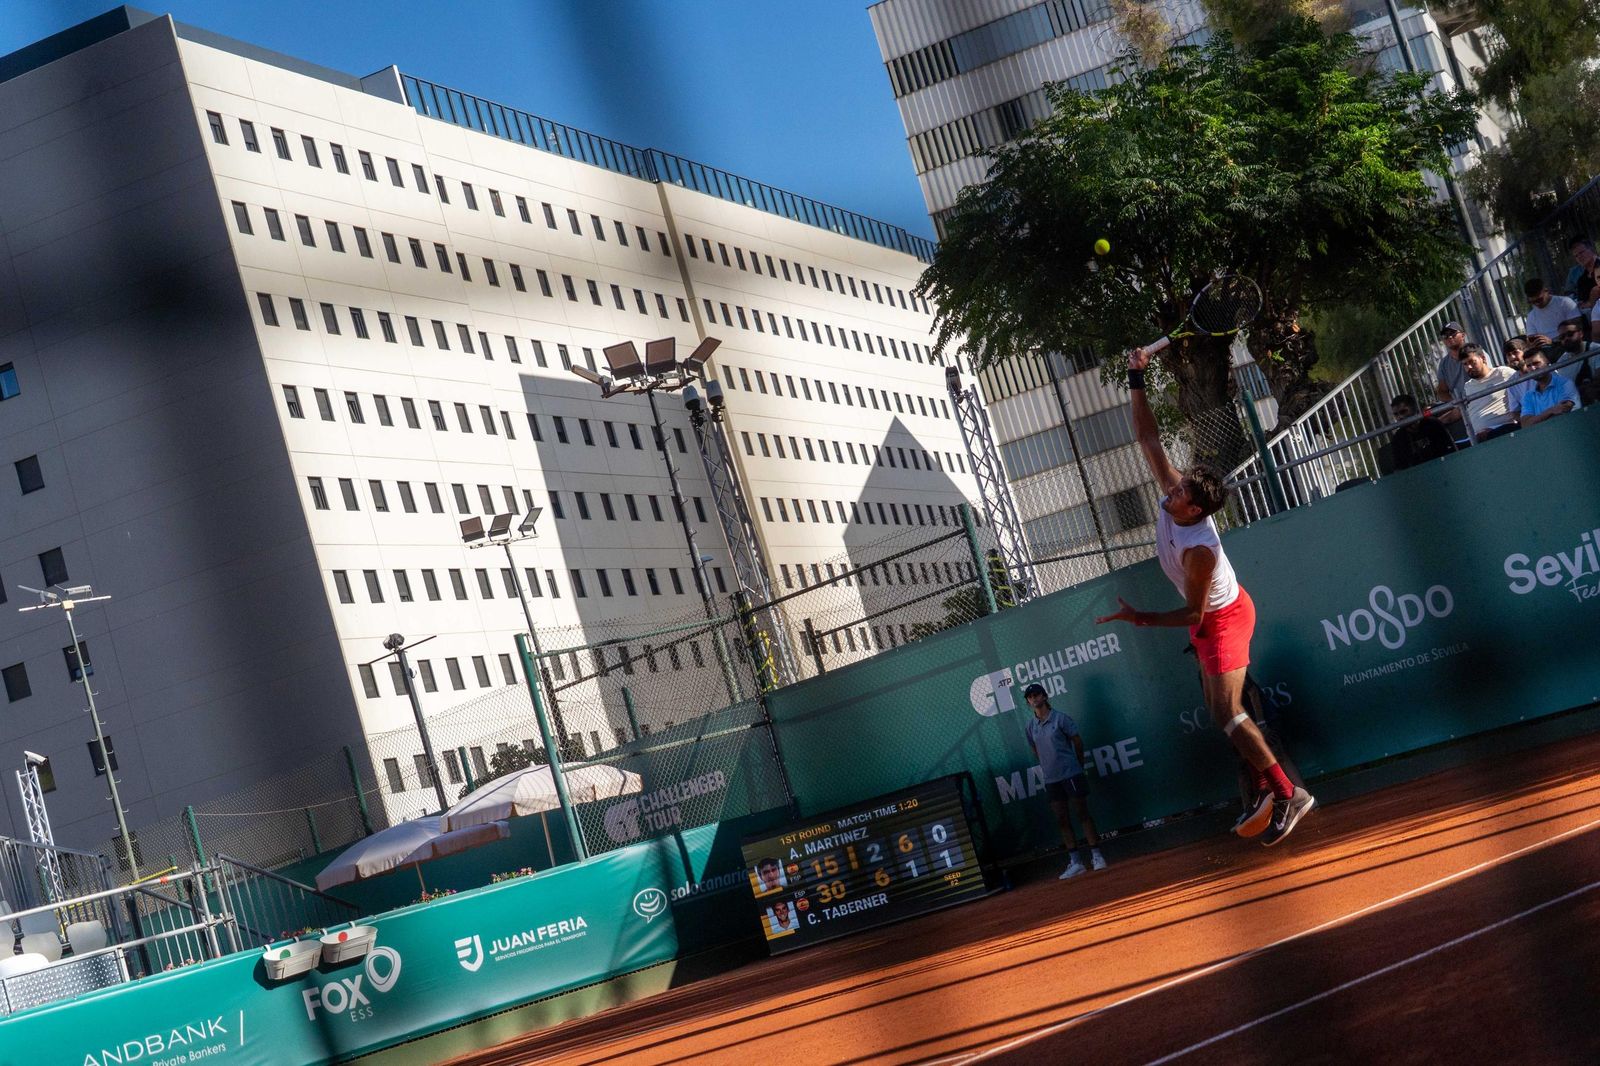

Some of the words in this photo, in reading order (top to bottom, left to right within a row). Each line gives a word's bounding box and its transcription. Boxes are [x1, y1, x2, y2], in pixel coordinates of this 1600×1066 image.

[1014, 632, 1122, 684] CHALLENGER
[997, 677, 1012, 688] ATP
[1020, 674, 1068, 699] UR
[640, 769, 727, 813] CHALLENGER
[995, 736, 1144, 805] MARE
[780, 834, 797, 846] 1ST
[799, 824, 832, 840] ROUND
[837, 811, 873, 830] MATCH
[872, 804, 898, 822] TIME
[899, 798, 919, 811] 1:20
[789, 847, 803, 860] A.
[804, 826, 870, 855] MARTINEZ
[810, 855, 839, 878] 15
[866, 843, 884, 863] 2
[898, 834, 914, 853] 6
[931, 824, 947, 844] 0
[816, 880, 846, 904] 30
[874, 867, 891, 888] 6
[905, 859, 919, 878] 1
[939, 849, 953, 869] 1
[807, 912, 821, 925] C.
[822, 892, 889, 920] TABERNER
[489, 929, 536, 955] JUAN
[537, 916, 588, 941] FERIA
[301, 974, 371, 1022] FOX
[350, 1006, 374, 1023] ESS
[83, 1015, 228, 1066] ANDBANK
[189, 1042, 227, 1062] Bankers
